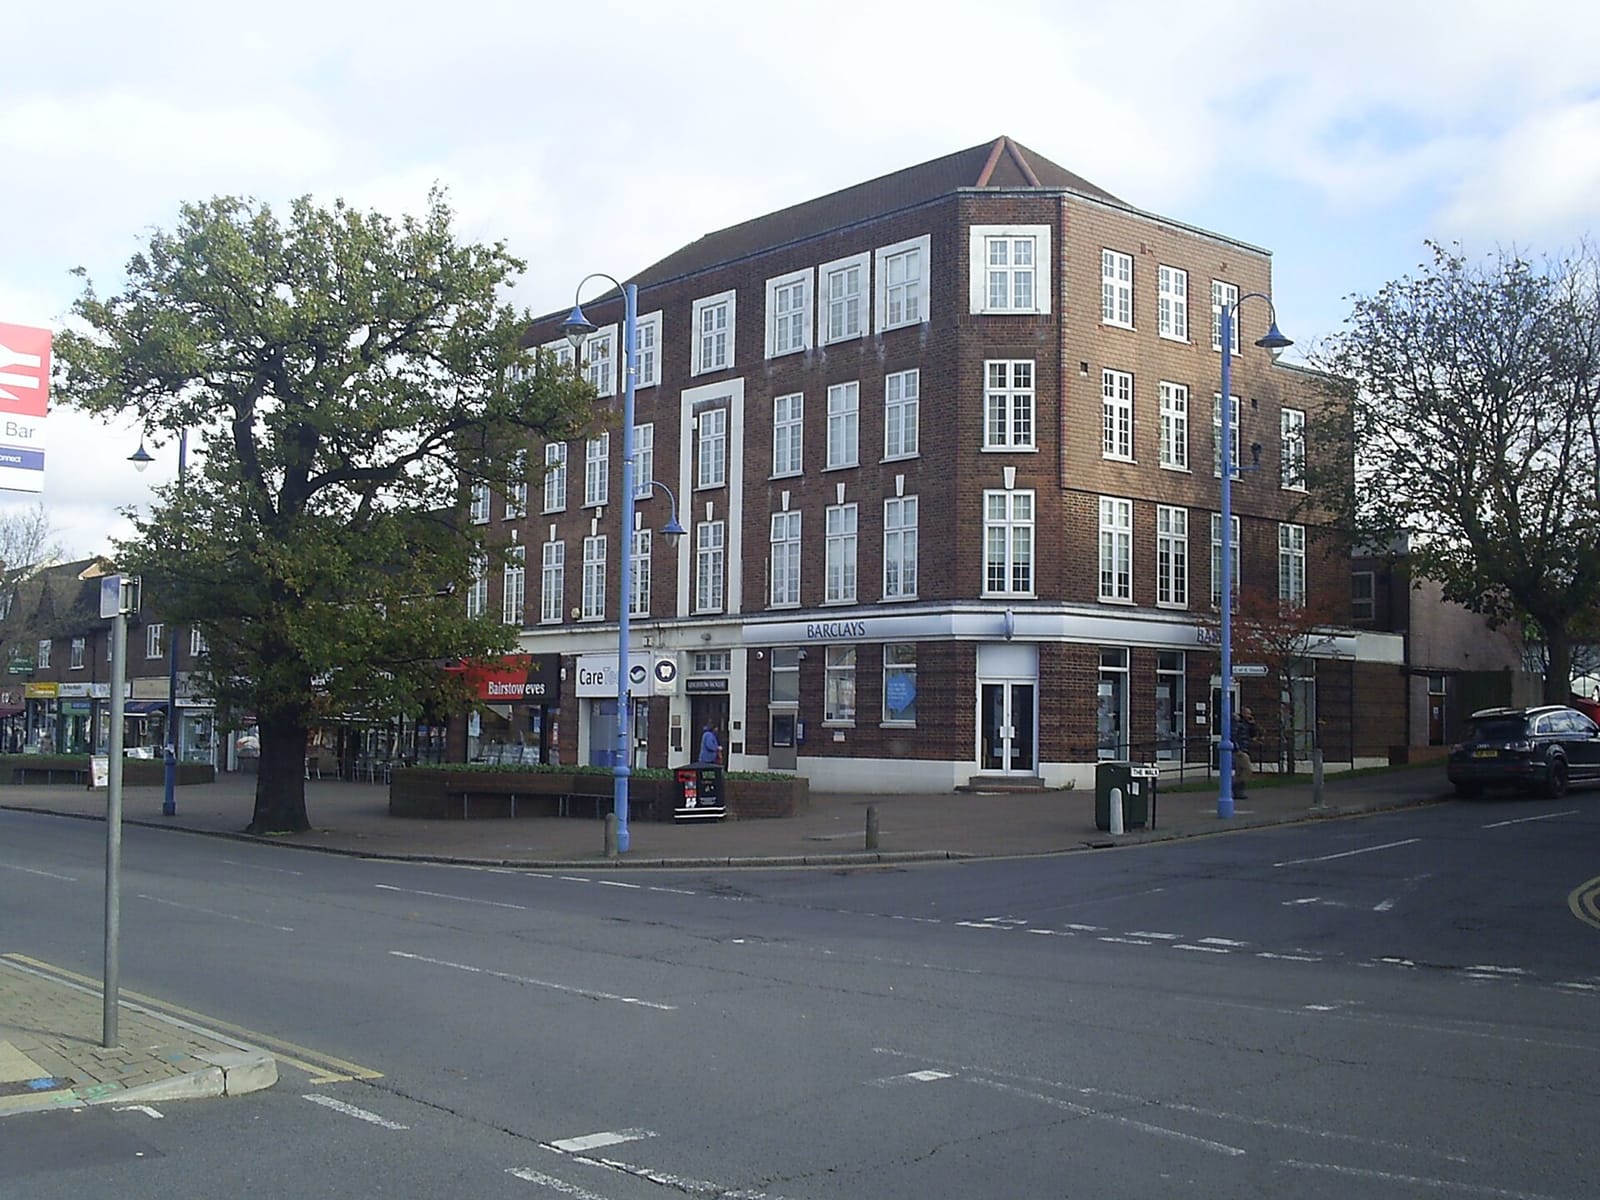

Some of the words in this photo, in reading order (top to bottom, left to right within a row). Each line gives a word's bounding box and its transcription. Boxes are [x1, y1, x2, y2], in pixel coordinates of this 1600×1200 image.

[5, 422, 36, 439] Bar
[807, 621, 865, 638] BARCLAYS
[488, 681, 525, 695] Bairstow
[525, 683, 545, 695] eves
